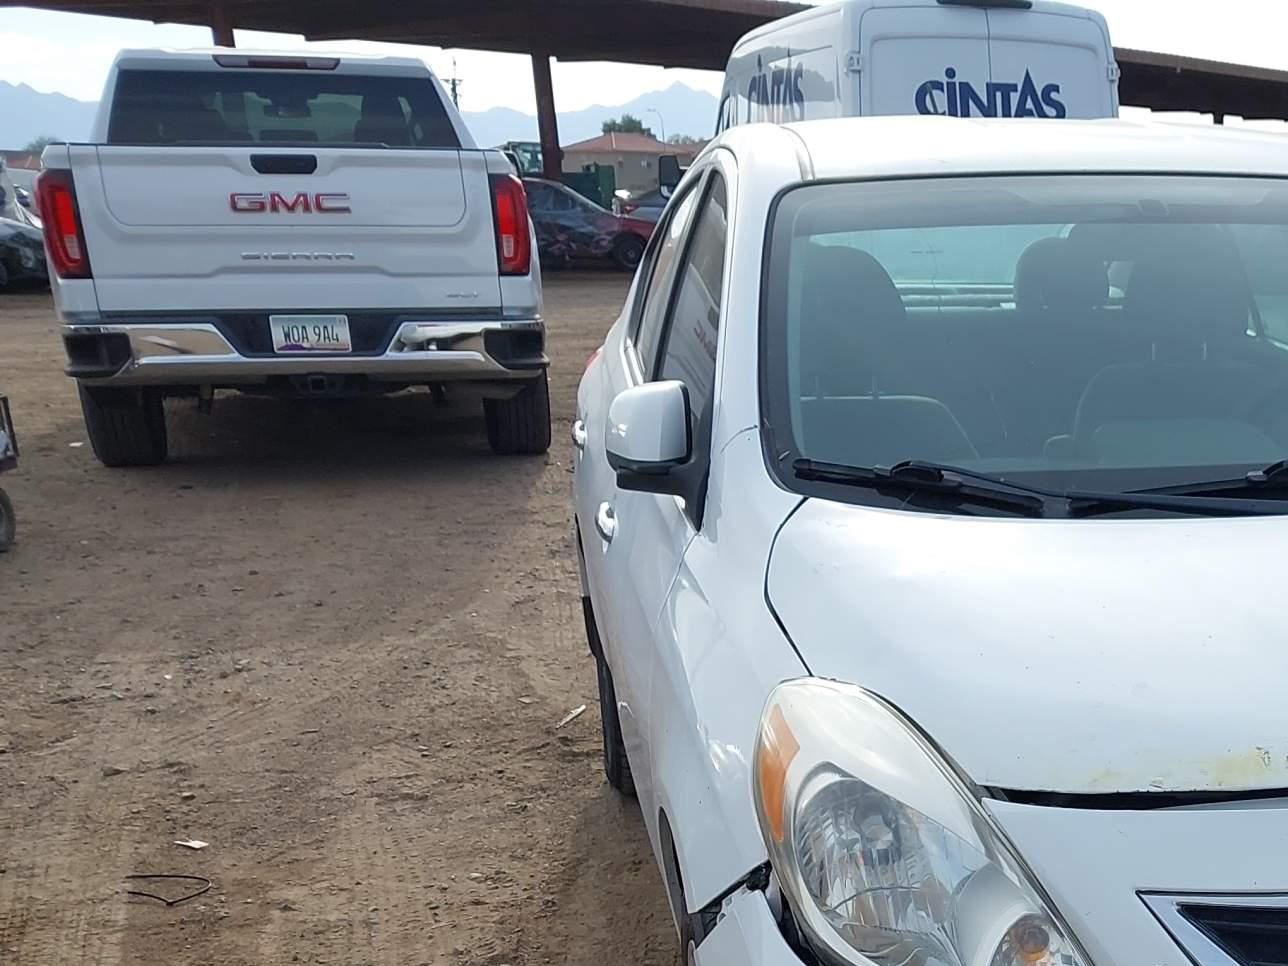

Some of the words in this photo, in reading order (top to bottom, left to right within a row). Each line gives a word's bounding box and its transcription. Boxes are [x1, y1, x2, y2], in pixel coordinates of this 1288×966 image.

[229, 191, 352, 214] GMC
[241, 252, 355, 260] SIERRA
[313, 325, 339, 343] 9A4
